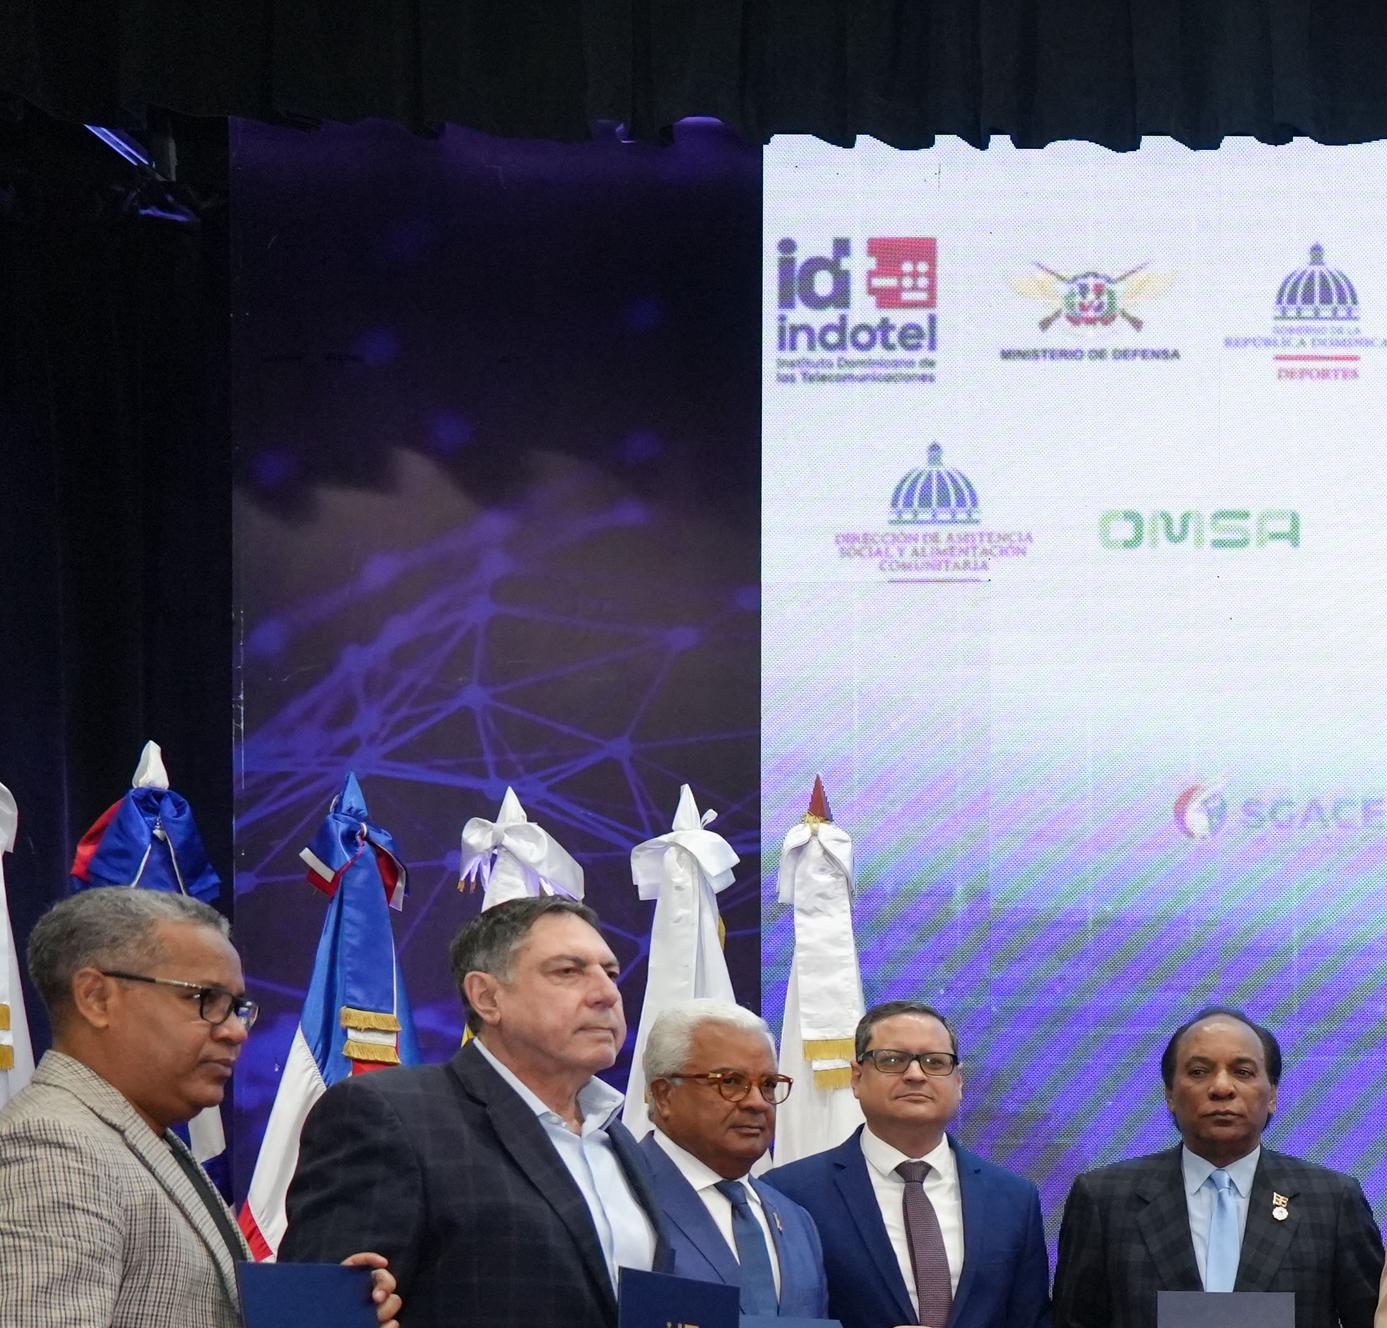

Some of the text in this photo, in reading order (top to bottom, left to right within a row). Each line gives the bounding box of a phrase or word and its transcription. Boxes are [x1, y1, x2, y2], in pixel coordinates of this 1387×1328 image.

[777, 236, 851, 311] id
[777, 314, 937, 352] indotel
[1000, 349, 1181, 361] MINISTERIO DE DEFENSA
[919, 357, 936, 369] de
[1277, 368, 1359, 380] DEPORTES
[1099, 509, 1301, 549] OMSA
[922, 532, 940, 544] DE
